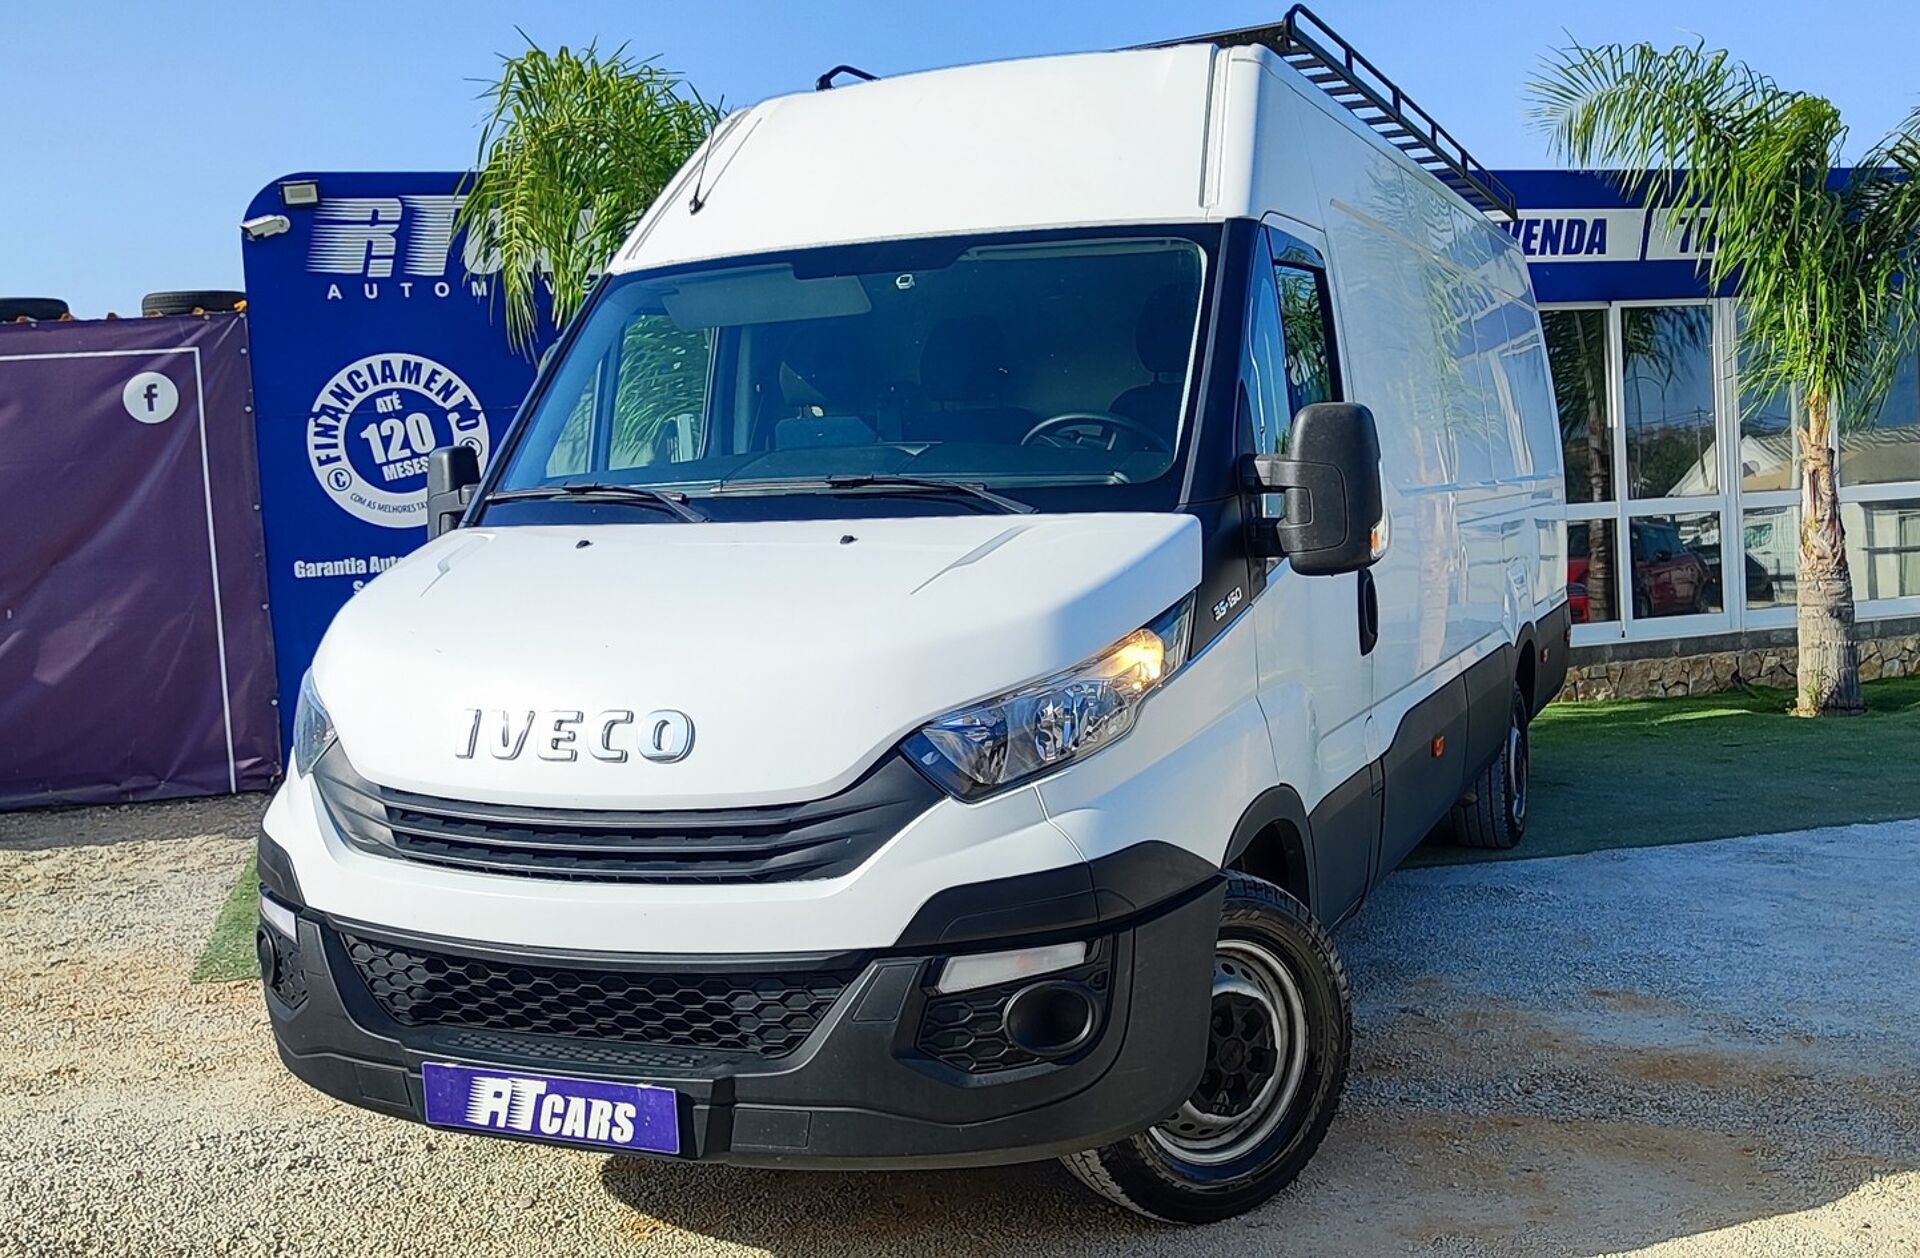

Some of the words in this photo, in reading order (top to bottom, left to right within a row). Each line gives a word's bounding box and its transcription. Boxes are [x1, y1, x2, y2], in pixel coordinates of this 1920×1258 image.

[313, 359, 481, 467] FINANCIAMENTO
[375, 391, 402, 413] ATÉ
[360, 412, 436, 464] 120
[382, 457, 430, 482] MESES
[350, 492, 367, 505] COM
[366, 501, 377, 510] AS
[377, 503, 416, 514] MELHORES
[293, 559, 367, 578] Garantia
[454, 708, 696, 763] IVECO
